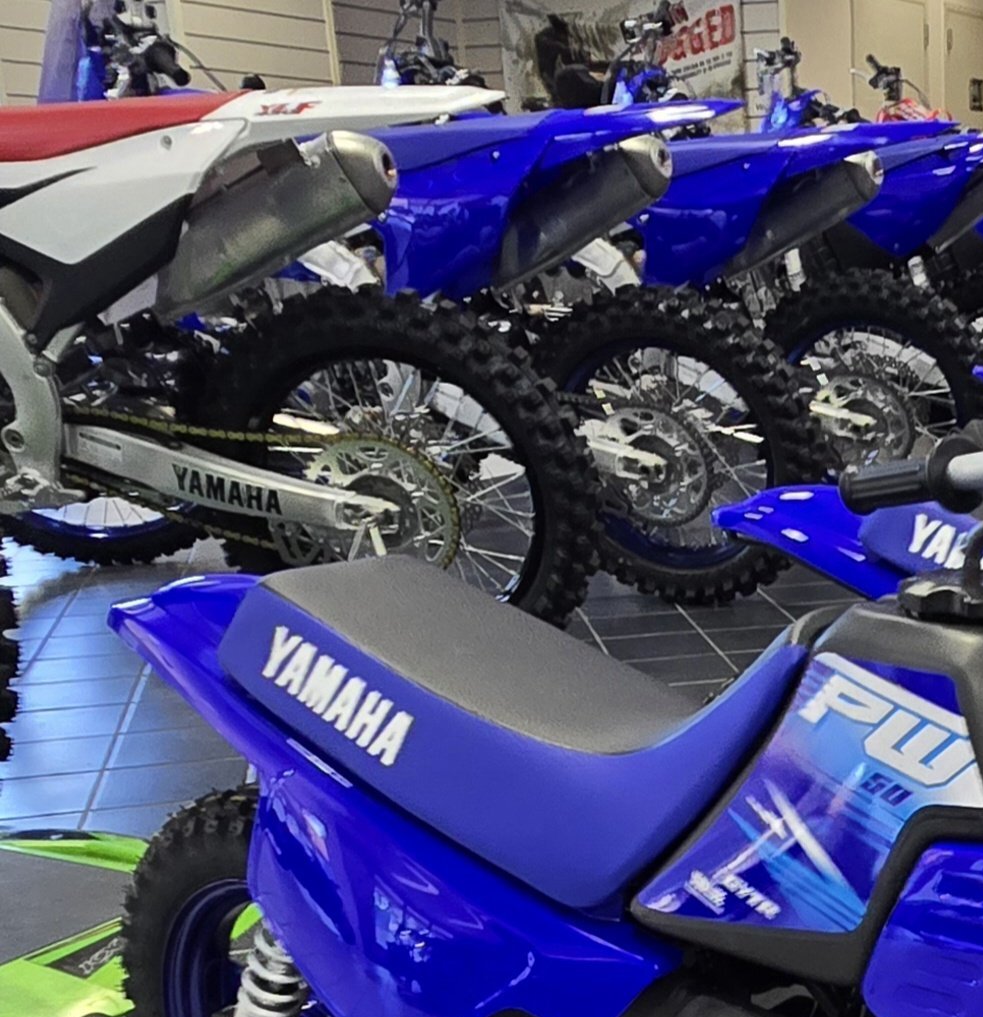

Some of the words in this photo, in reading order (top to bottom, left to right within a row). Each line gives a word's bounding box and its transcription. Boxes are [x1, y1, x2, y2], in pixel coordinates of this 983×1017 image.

[172, 463, 282, 516] YAMAHA
[261, 625, 415, 767] YAMAHA
[798, 673, 977, 788] PW
[860, 772, 914, 807] 50
